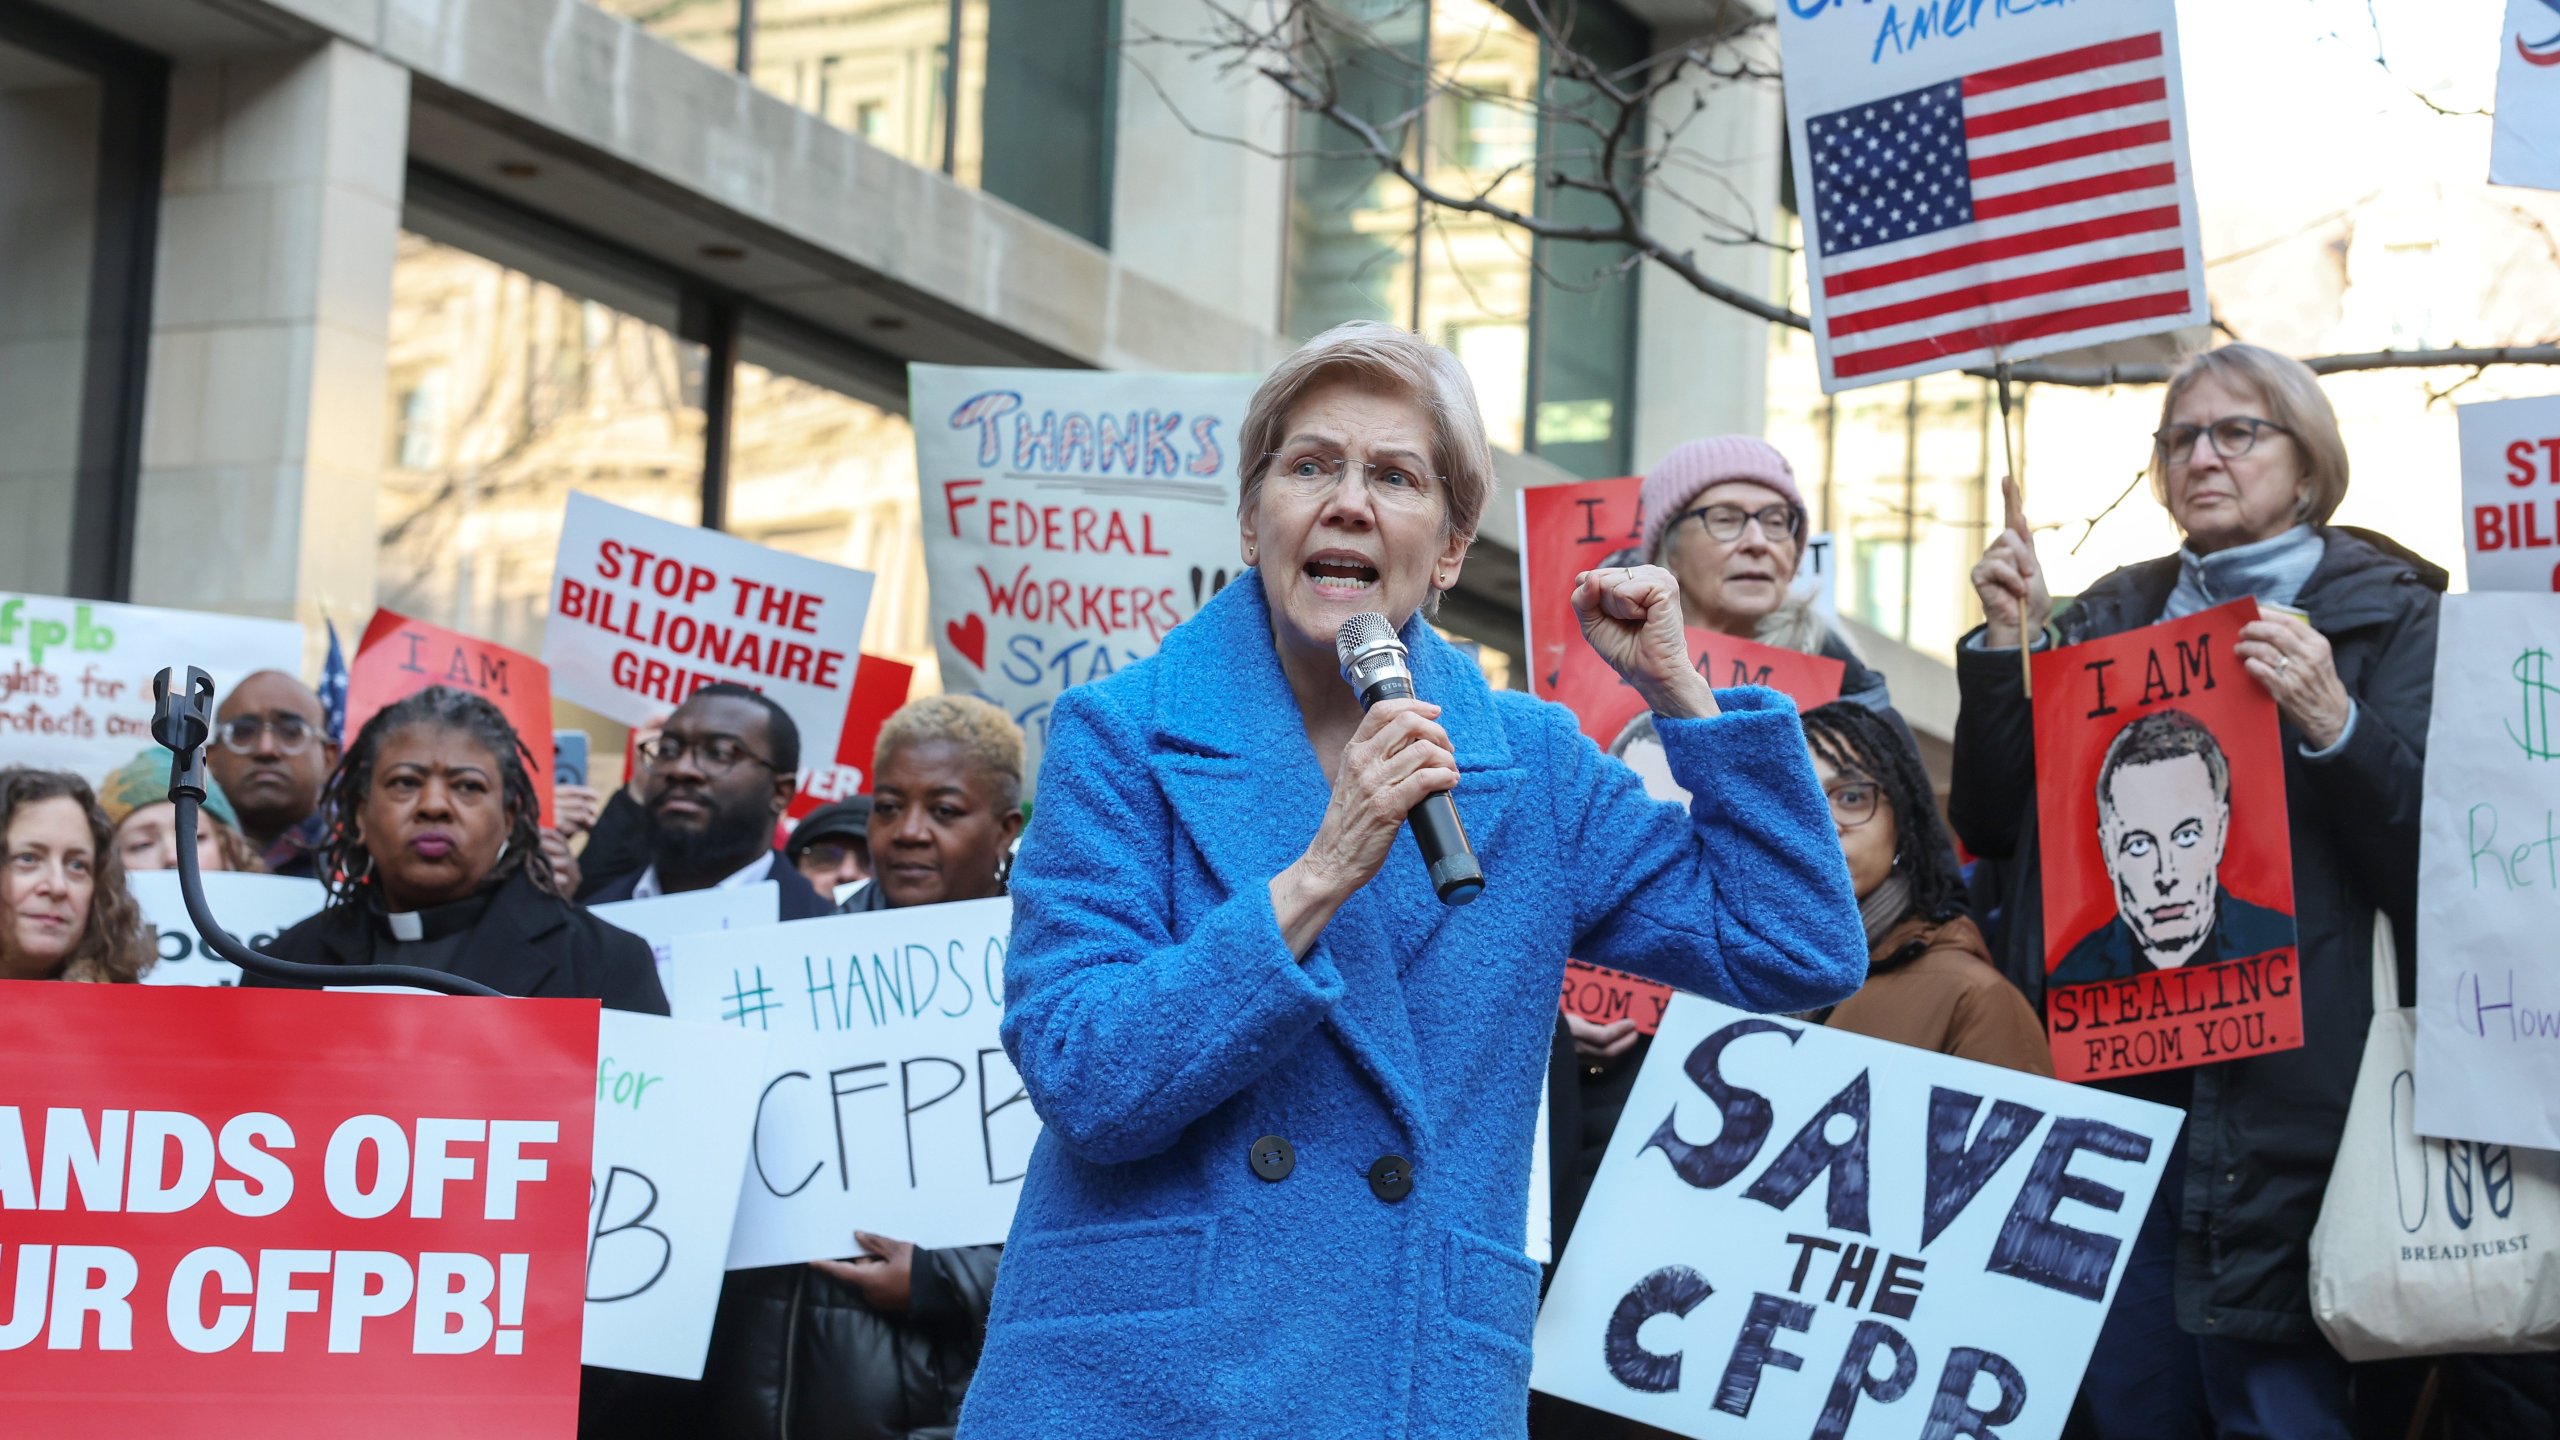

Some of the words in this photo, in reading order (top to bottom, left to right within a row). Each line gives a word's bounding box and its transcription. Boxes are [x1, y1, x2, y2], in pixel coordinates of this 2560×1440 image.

[949, 390, 1224, 476] THANKS
[943, 479, 1171, 557] FEDERAL
[596, 539, 717, 604] STOP
[731, 577, 825, 635] THE
[976, 564, 1182, 642] WORKERS
[400, 631, 427, 674] I
[446, 650, 511, 696] AM
[558, 577, 845, 691] BILLIONAIRE
[1001, 634, 1140, 689] STA
[2084, 657, 2119, 720] I
[2138, 633, 2216, 706] AM
[79, 662, 125, 699] for
[2053, 954, 2294, 1034] STEALING
[597, 1056, 664, 1110] for
[2084, 1027, 2184, 1074] FROM
[2196, 1012, 2279, 1057] YOU.
[754, 1048, 1029, 1197] CFPB
[1635, 1018, 2154, 1304] SAVE
[323, 1113, 560, 1221] OFF
[585, 1166, 672, 1304] B
[1785, 1231, 1927, 1321] THE
[2401, 1244, 2468, 1261] BREAD
[2472, 1233, 2530, 1257] FURST
[0, 1242, 140, 1351] UR
[166, 1245, 530, 1356] CFPB!
[1602, 1263, 2028, 1440] CFPB
